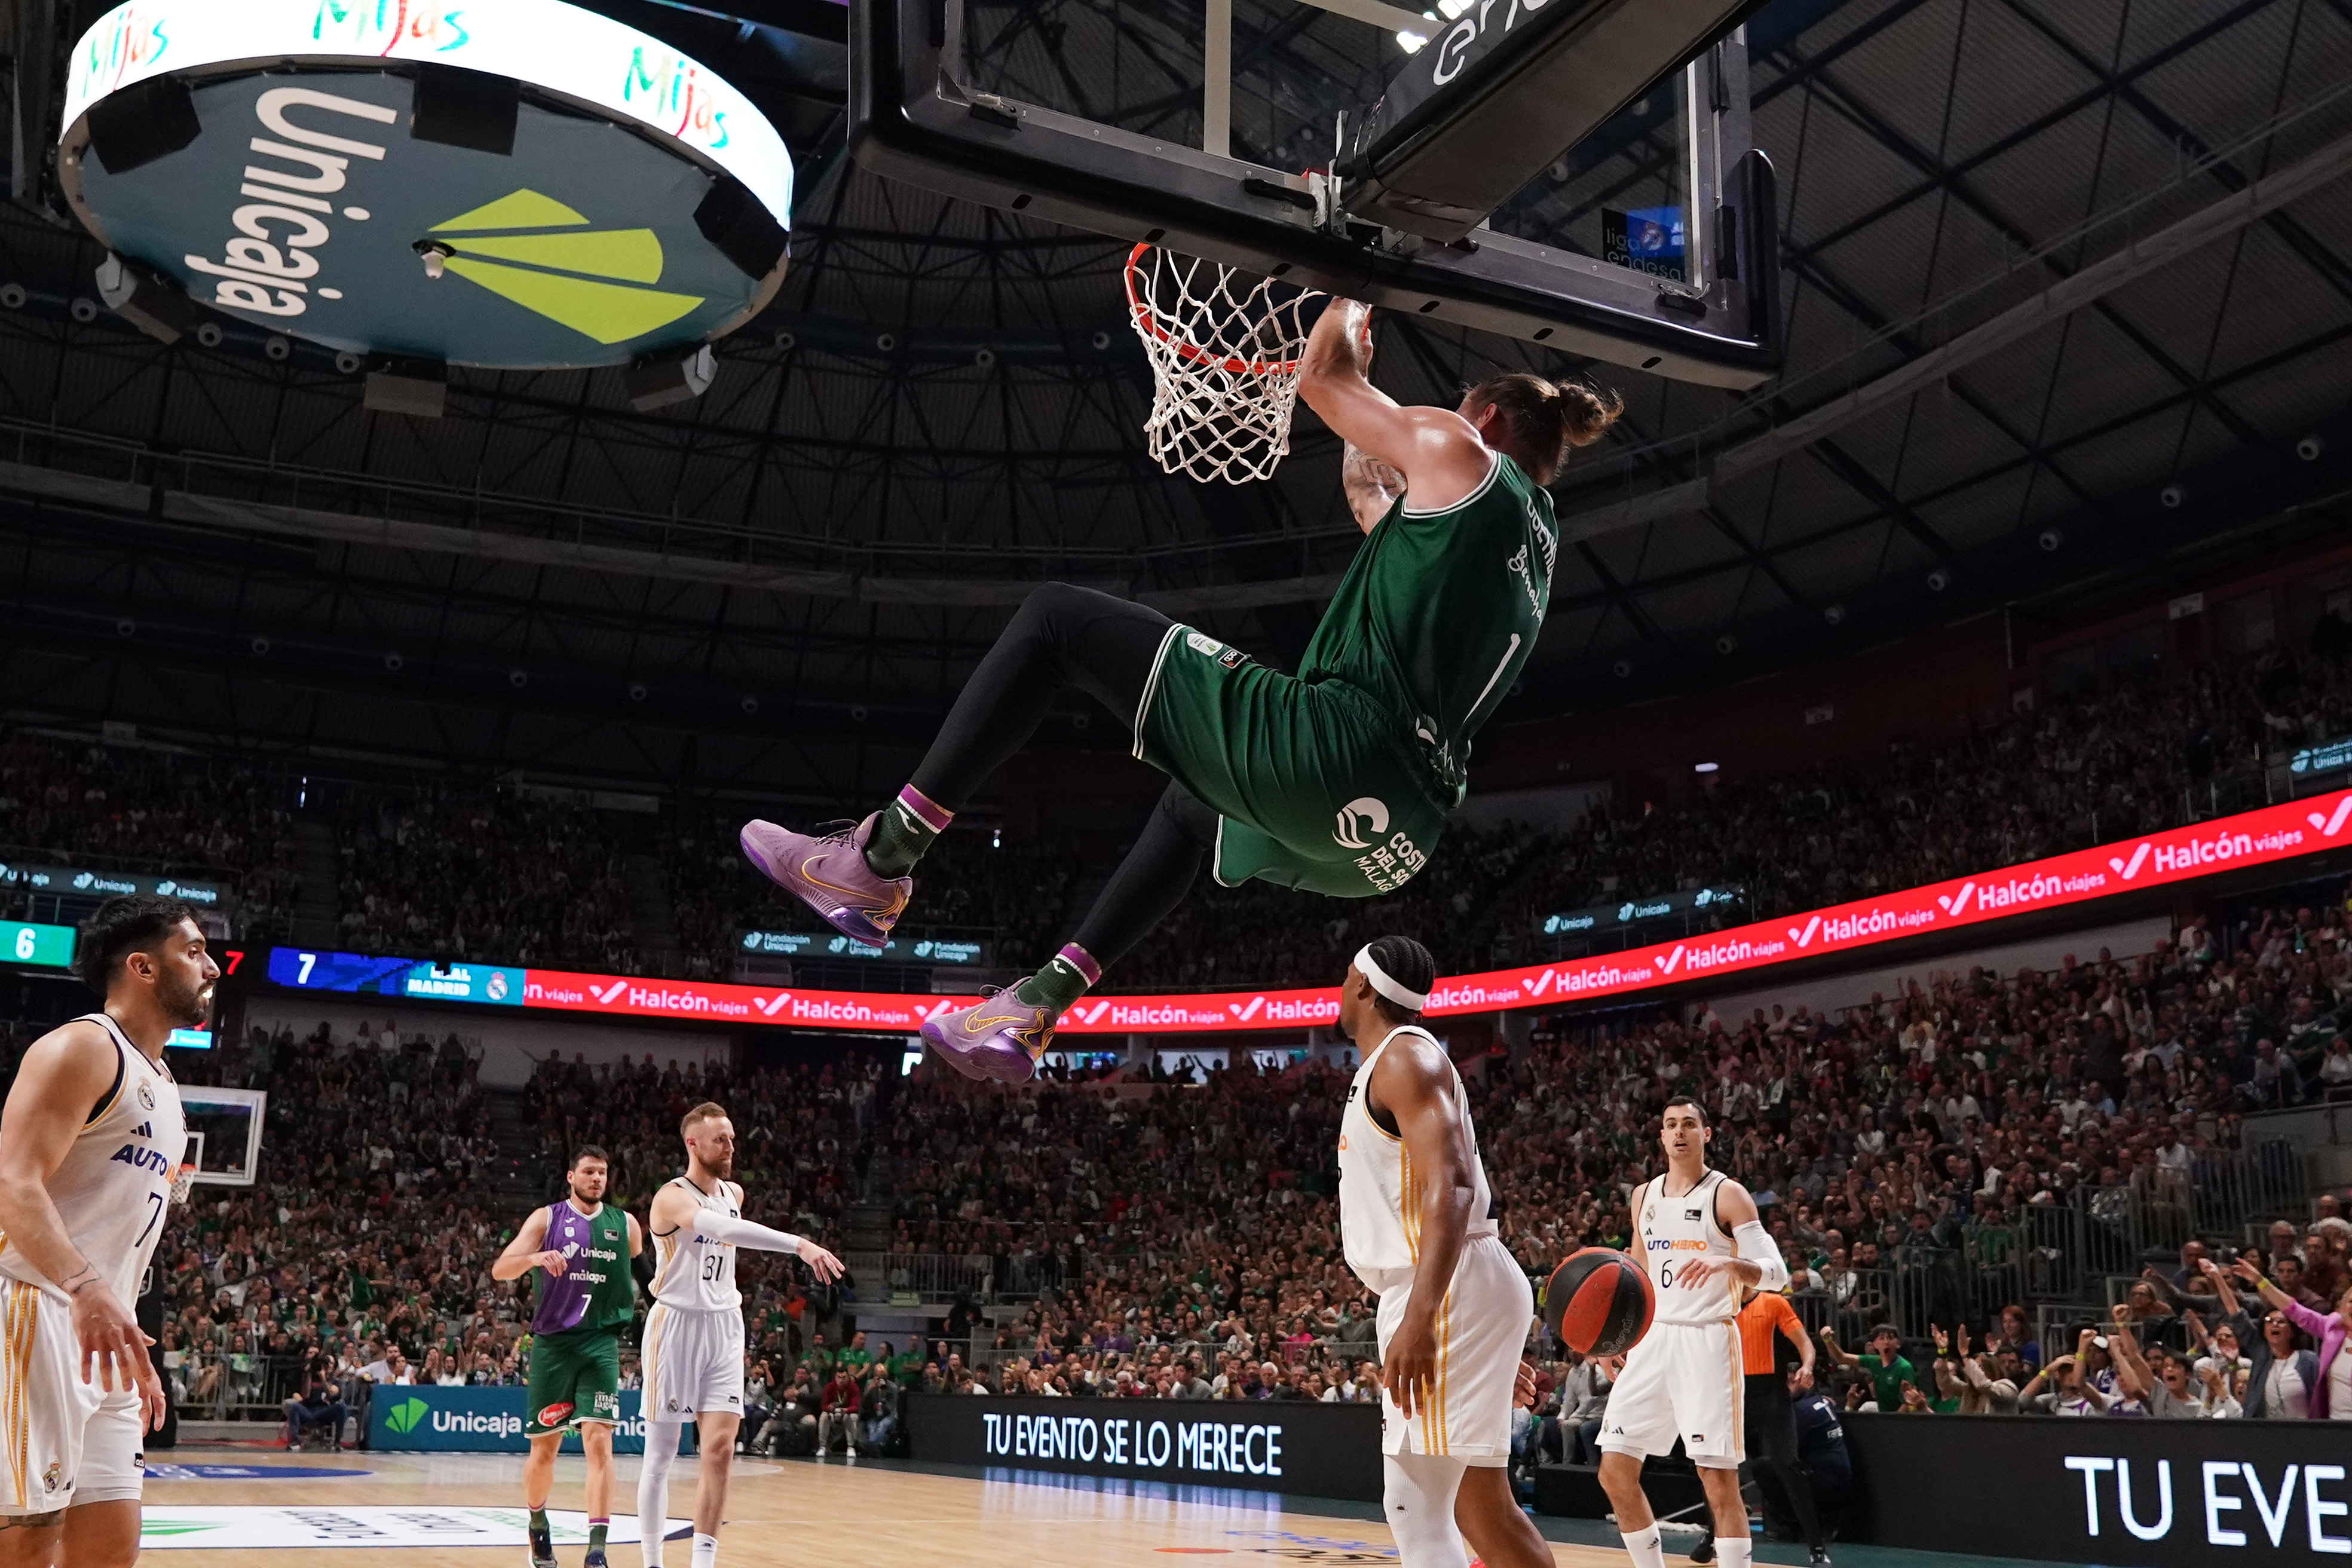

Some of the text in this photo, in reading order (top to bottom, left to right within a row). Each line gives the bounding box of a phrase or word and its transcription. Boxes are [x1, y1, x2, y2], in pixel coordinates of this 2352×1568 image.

[313, 0, 470, 57] Mijas
[82, 8, 169, 99] Mijas
[623, 46, 728, 149] Mijas
[184, 87, 398, 317] Unicaja
[1371, 846, 1397, 874] DEL
[2154, 829, 2303, 872] Halcón viajes
[1977, 872, 2106, 911] Halcón viajes
[1823, 908, 1935, 943] Halcón viajes
[16, 927, 35, 960] 6
[1685, 939, 1785, 970] Halcón viajes
[225, 950, 244, 975] 7
[298, 953, 316, 985] 7
[408, 978, 470, 997] MADRID
[1556, 964, 1652, 993] Halcón viajes
[544, 989, 584, 1003] viajes
[629, 987, 749, 1015] Halcón viajes
[1266, 997, 1340, 1020] Halcón
[1486, 988, 1520, 1003] viajes
[792, 999, 911, 1024] Halcón viajes
[1111, 1004, 1225, 1025] Halcón viajes
[134, 1192, 163, 1248] 7
[580, 1247, 617, 1262] Unicaja
[702, 1255, 723, 1281] 31
[569, 1269, 607, 1284] málaga
[1661, 1259, 1673, 1288] 6
[580, 1294, 592, 1317] 7
[433, 1410, 522, 1439] Unicaja
[983, 1413, 1282, 1476] TU EVENTO SE LO MERECE
[2063, 1456, 2352, 1554] TU EVE
